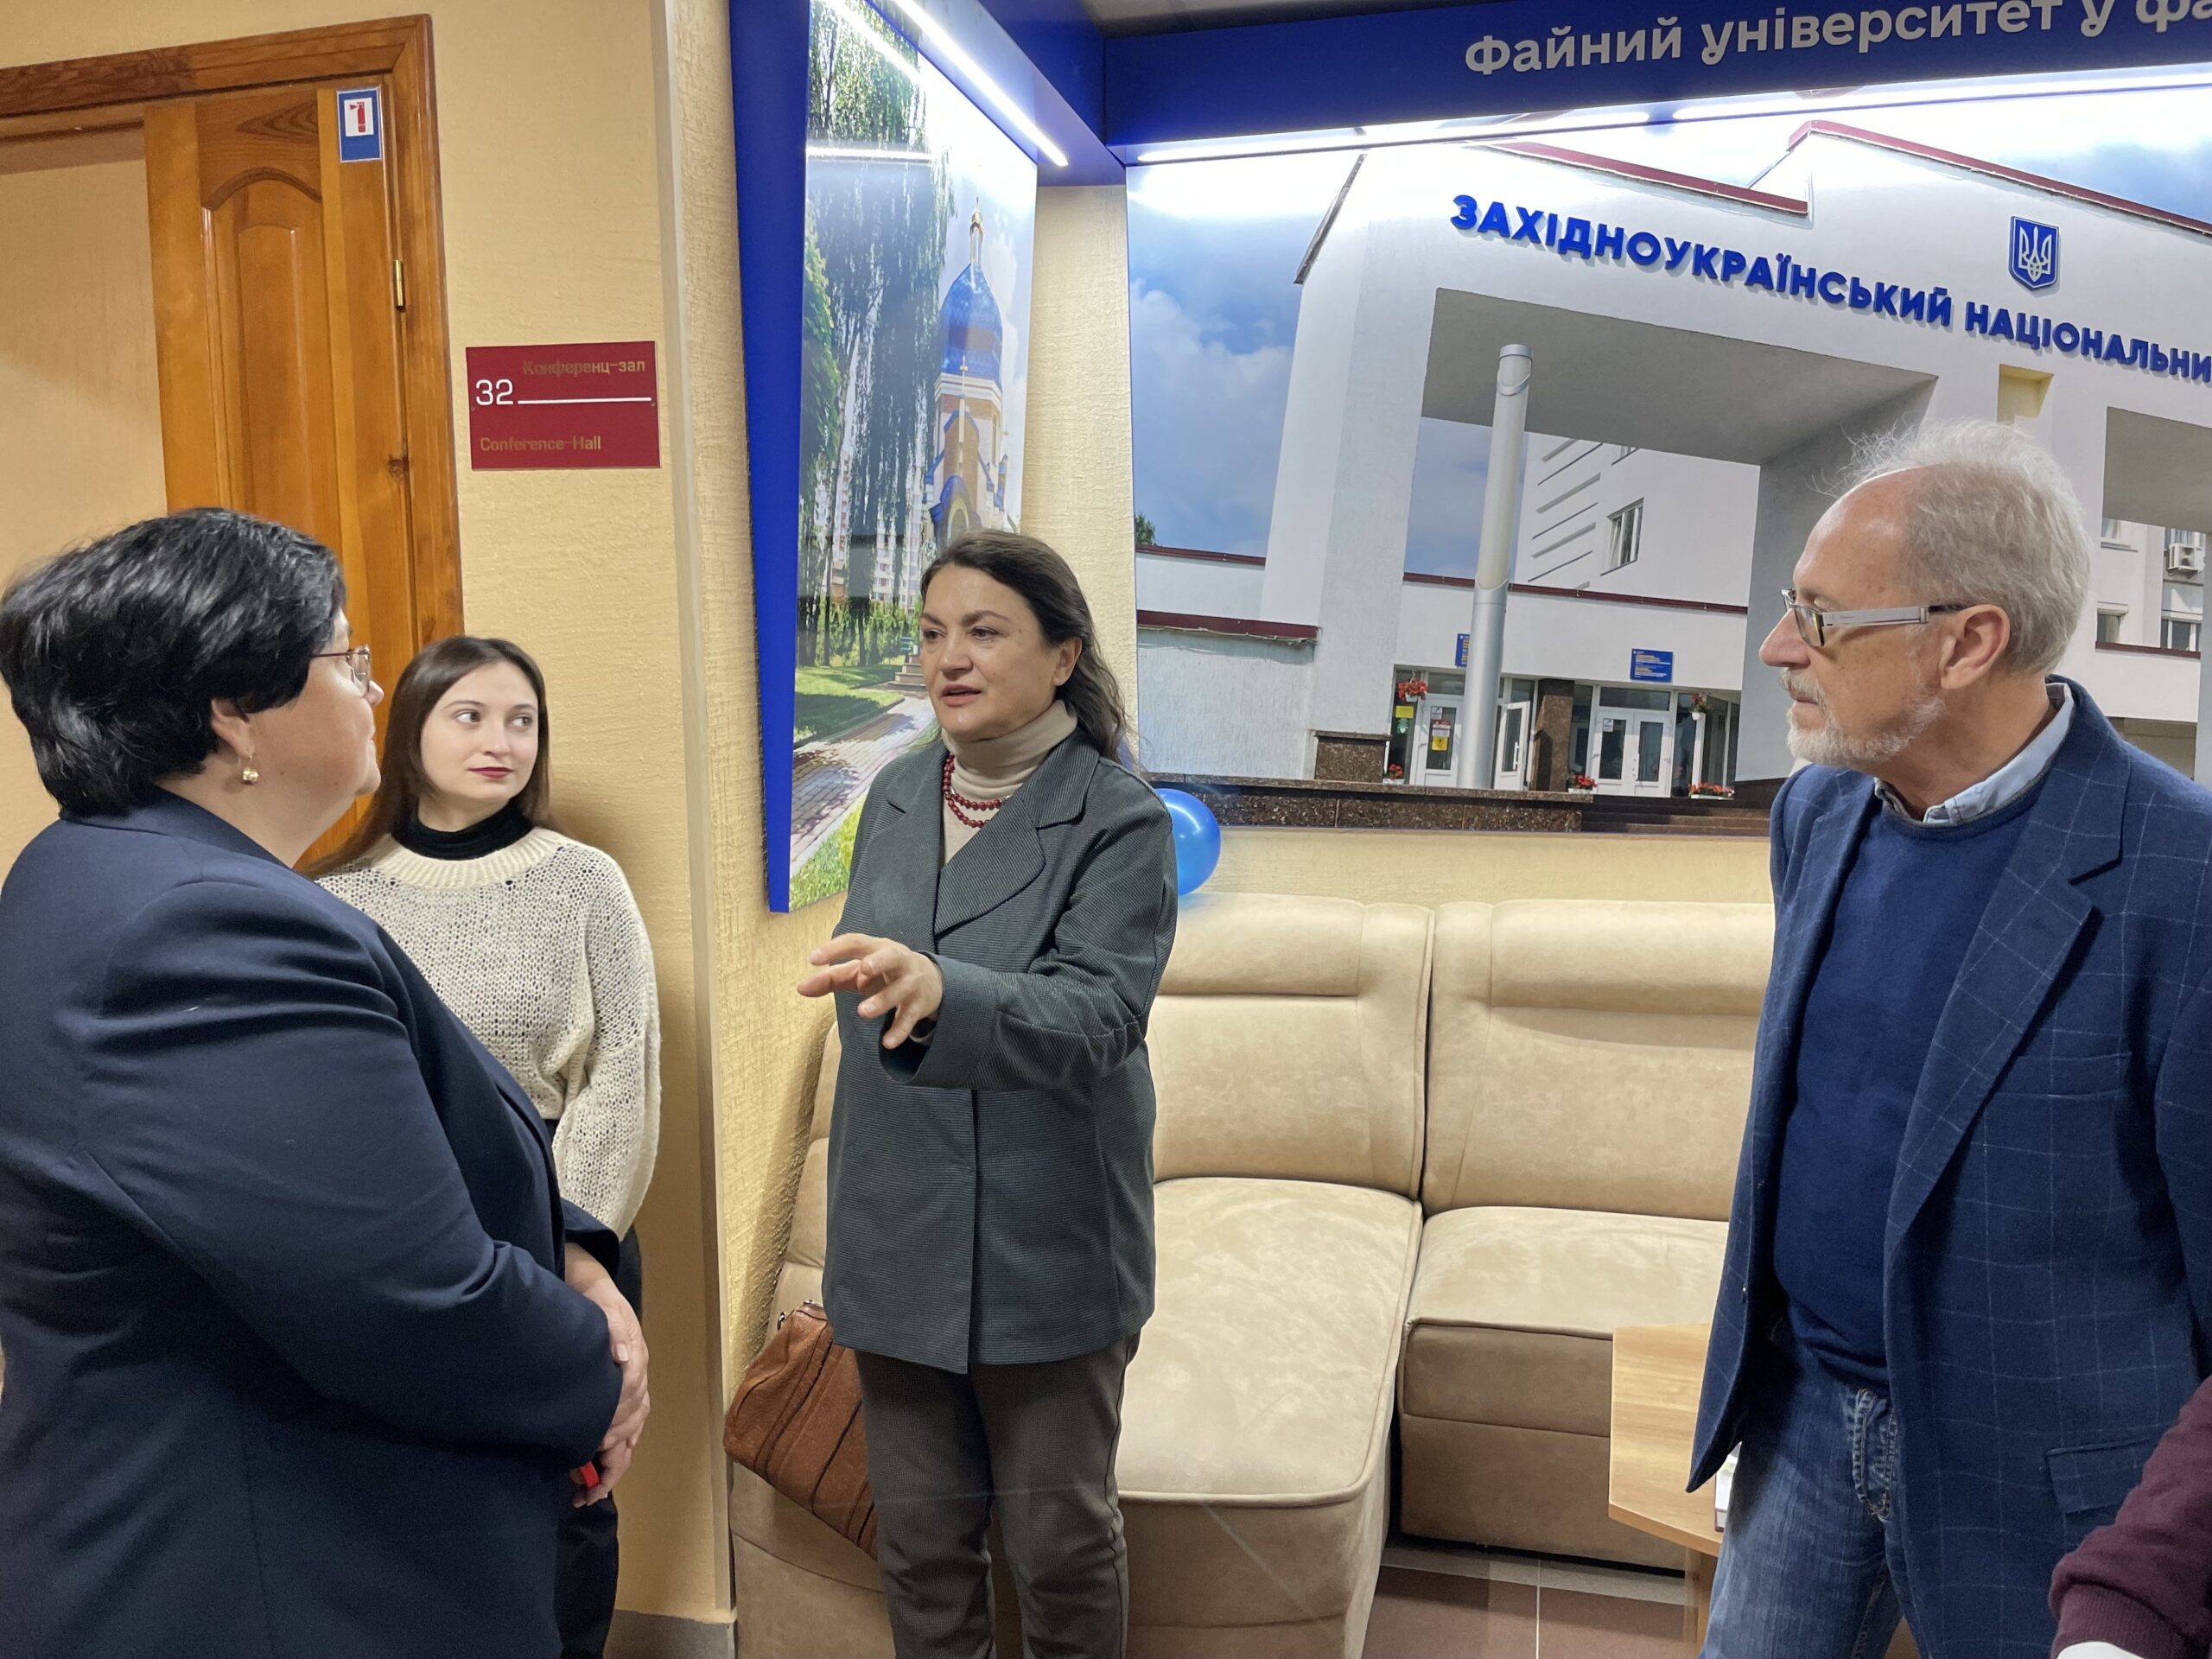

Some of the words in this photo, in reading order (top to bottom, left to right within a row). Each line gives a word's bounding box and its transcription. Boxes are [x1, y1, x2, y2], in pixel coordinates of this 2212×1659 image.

[1465, 16, 1682, 76] Файний
[1700, 0, 2063, 66] університет
[2080, 0, 2116, 38] у
[1450, 194, 1953, 327] ЗАХІДНОУКРАЇНСЬКИЙ
[522, 359, 645, 377] Конференц-зал
[475, 378, 514, 406] 32
[480, 435, 601, 452] Conference-Hall
